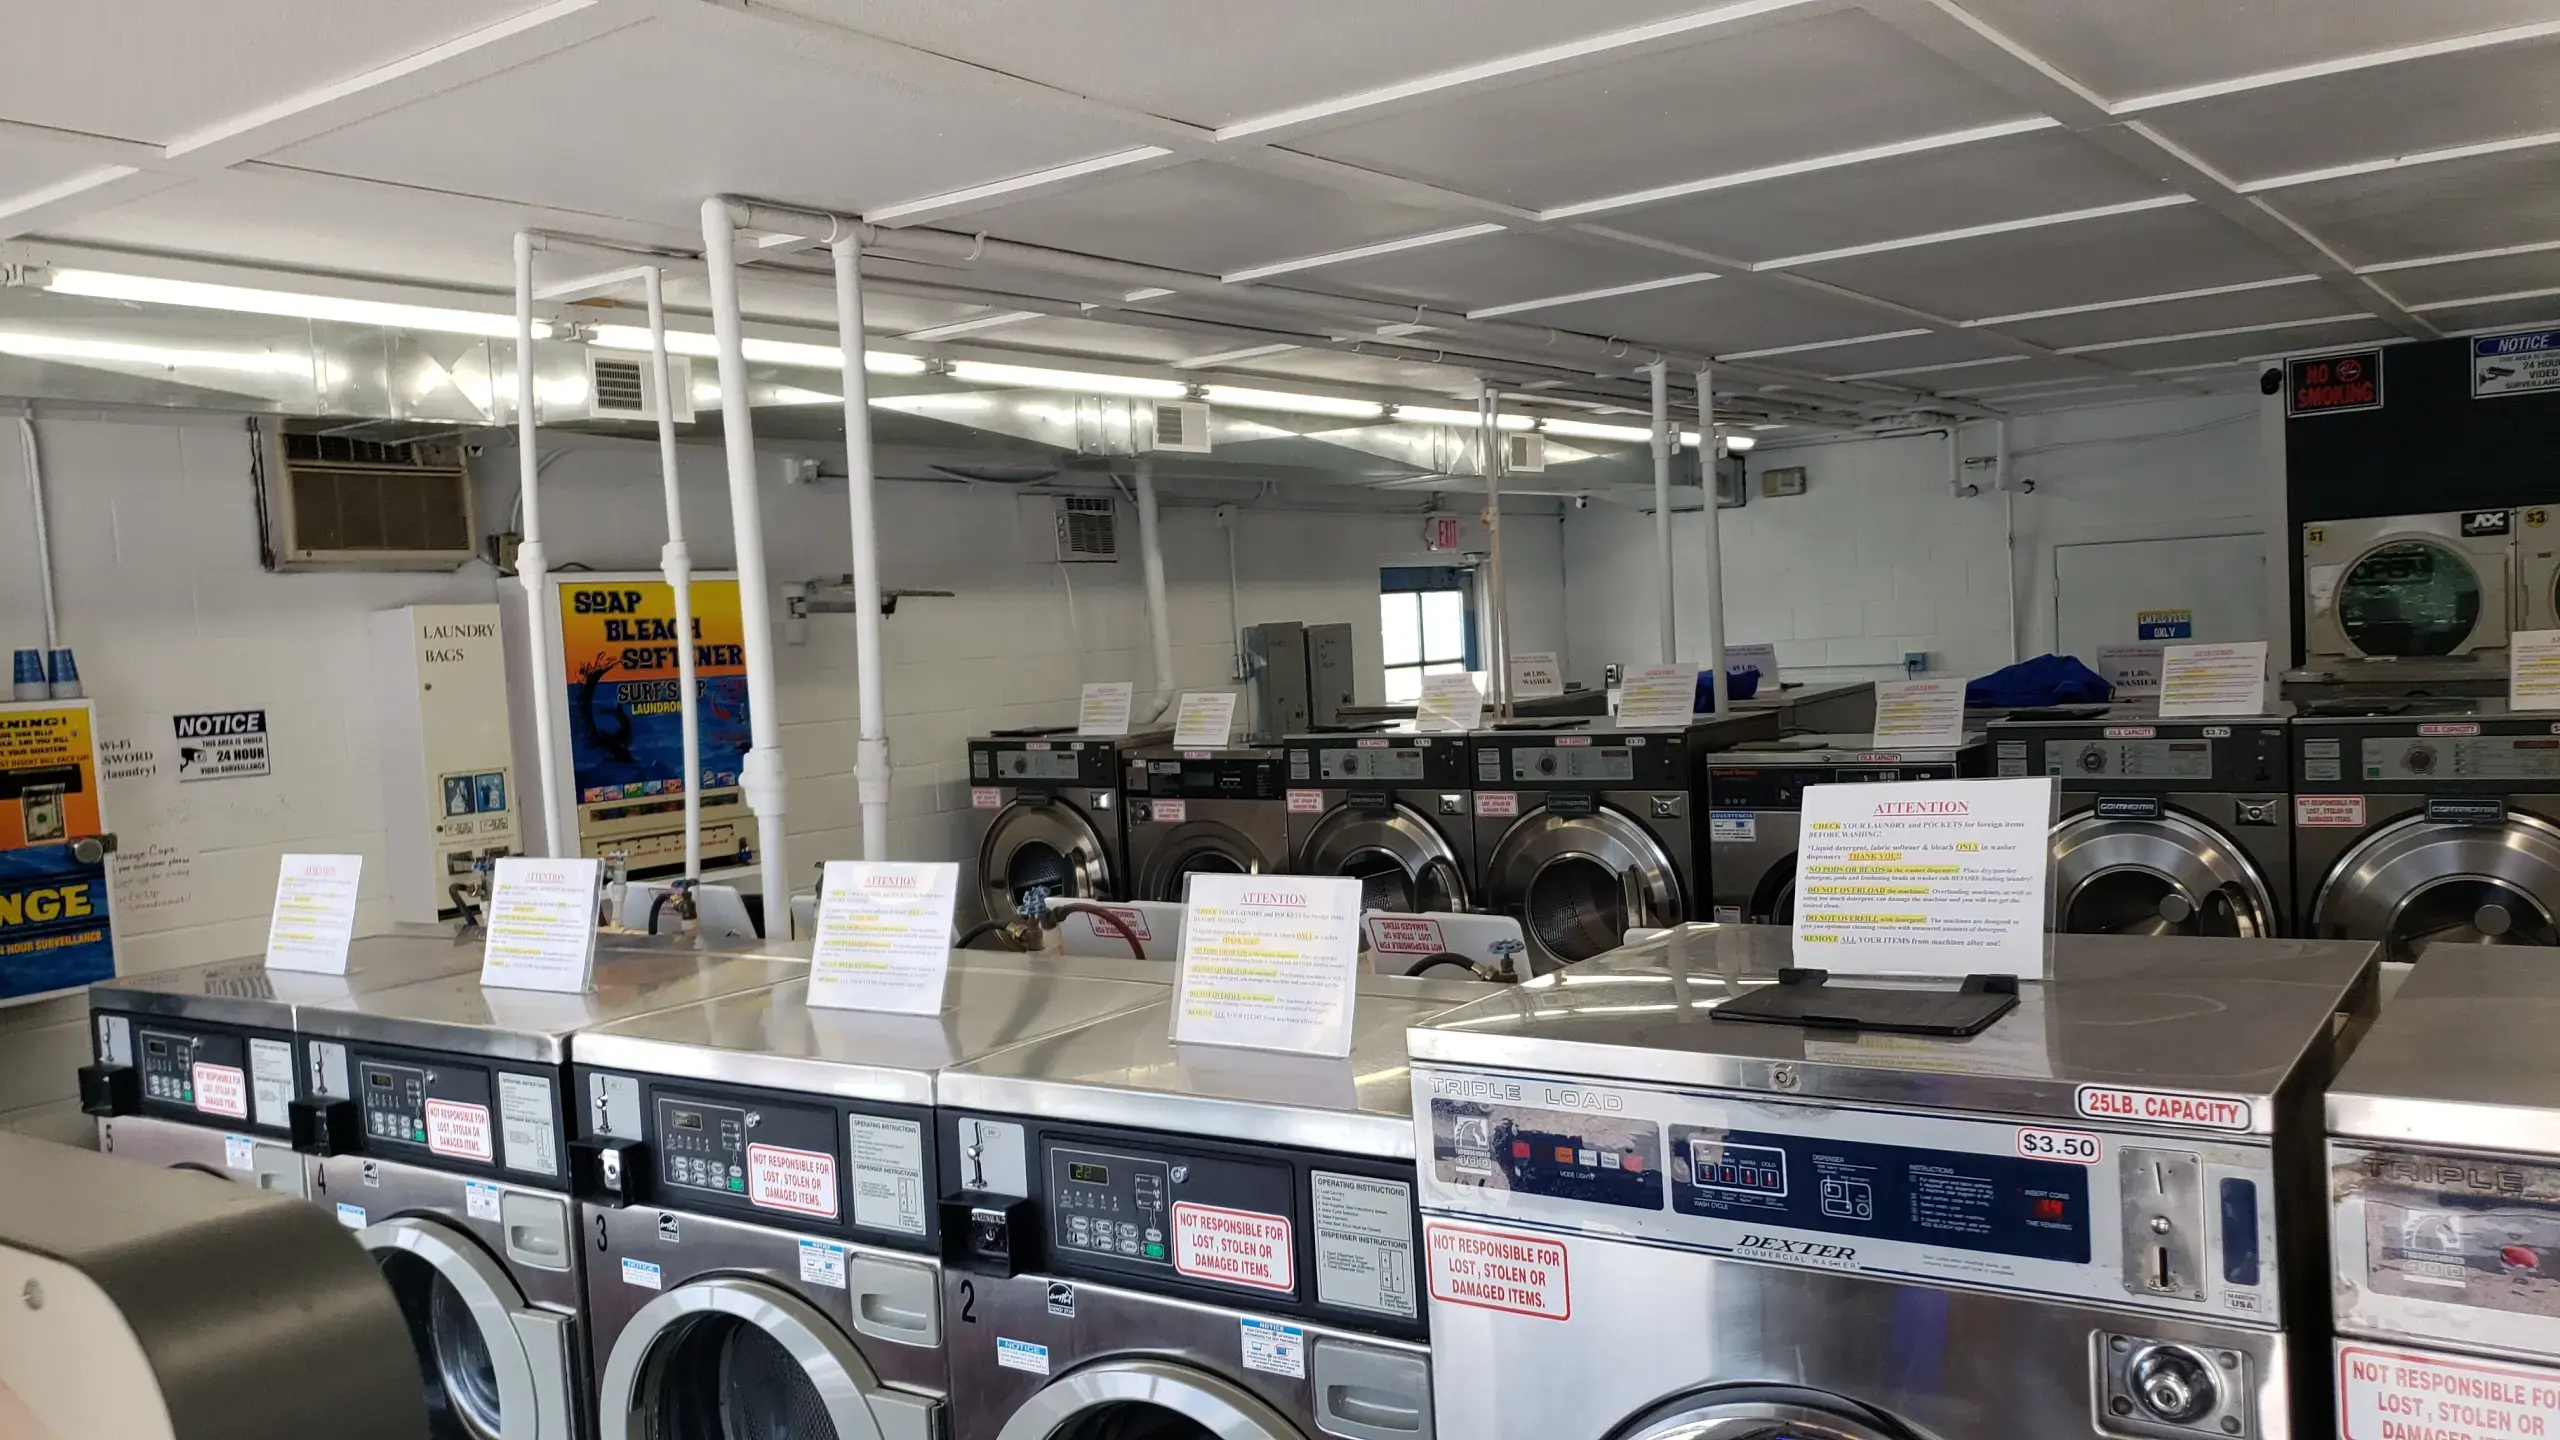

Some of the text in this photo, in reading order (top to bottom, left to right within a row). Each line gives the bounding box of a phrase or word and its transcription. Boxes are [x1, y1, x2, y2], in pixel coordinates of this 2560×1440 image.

[2498, 334, 2549, 352] NOTICE
[2307, 363, 2329, 384] NO
[2529, 369, 2558, 378] VIDEO
[2298, 381, 2373, 408] SMOKING
[2473, 512, 2504, 528] ADC
[574, 591, 642, 614] SOAP
[2140, 614, 2189, 624] EMPLOYEES
[423, 624, 496, 639] LAUNDRY
[2154, 627, 2175, 637] ONLY
[425, 649, 464, 663] BAGS
[623, 644, 745, 670] SOFTNER
[617, 681, 678, 703] SURF'S
[179, 713, 260, 737] NOTICE
[218, 739, 233, 747] AREA
[243, 736, 263, 744] UNDER
[217, 747, 264, 762] 24 HOUR
[201, 763, 265, 775] VIDEO SURVEILLANCE
[1874, 801, 1969, 814] ATTENTION
[1977, 821, 2003, 829] foreign
[1842, 830, 1882, 838] WASHING!
[1955, 843, 1979, 851] ONLY
[1806, 853, 1841, 861] dispensers
[865, 876, 916, 886] ATTENTION
[1840, 886, 1886, 894] OVERLOAD
[1241, 893, 1307, 904] ATTENTION
[7, 942, 33, 955] HOUR
[36, 931, 101, 950] SURVEILLANCE
[1931, 938, 1965, 946] machines
[1429, 1077, 1623, 1111] TRIPLE LOAD
[430, 1107, 485, 1124] NOT RESPONSIBLE FOR
[2089, 1092, 2240, 1124] 25LB. CAPACITY
[453, 1124, 471, 1137] STOLEN
[473, 1126, 480, 1137] OR
[854, 1119, 917, 1135] OPERATING INSTRUCTIONS
[105, 1124, 113, 1152] 5
[440, 1136, 481, 1152] DAMAGED ITEMS.
[2023, 1133, 2095, 1157] $3.50
[753, 1153, 829, 1175] NOT RESPONSIBLE FOR
[1455, 1156, 1492, 1169] 400
[1812, 1154, 1844, 1163] DISPENSER
[857, 1163, 919, 1178] DISPENSER INSTRUCTIONS
[1560, 1171, 1595, 1180] MODE LIGHTS
[1909, 1165, 1954, 1175] INSTRUCTIONS
[2362, 1157, 2524, 1194] TRIPLE
[318, 1162, 326, 1195] 4
[785, 1173, 810, 1189] STOLEN
[812, 1178, 821, 1190] OR
[1318, 1178, 1405, 1197] OPERATING INSTRUCTIONS
[765, 1187, 822, 1207] DAMAGED ITEMS.
[2049, 1192, 2069, 1200] COINS
[1694, 1200, 1729, 1210] WASH CYCLE
[596, 1214, 607, 1252] 3
[1180, 1213, 1283, 1241] NOT RESPONSIBLE FOR
[2039, 1221, 2073, 1231] REMAINING
[1222, 1238, 1256, 1256] STOLEN
[1259, 1244, 1272, 1259] OR
[1321, 1231, 1407, 1250] DISPENSER INSTRUCTIONS
[1737, 1235, 1856, 1260] DEXTER
[1433, 1233, 1560, 1267] NOT RESPONSIBLE FOR
[1195, 1254, 1272, 1278] DAMAGED ITEMS.
[1737, 1248, 1856, 1269] COMMERCIAL WASHER
[1484, 1262, 1526, 1284] STOLEN
[1530, 1270, 1546, 1286] OR
[2403, 1260, 2466, 1278] 400
[960, 1278, 977, 1324] 2
[1452, 1279, 1545, 1308] DAMAGED ITEMS.
[1064, 1307, 1073, 1315] STAR
[2232, 1300, 2253, 1309] USA
[1260, 1322, 1284, 1331] NOTICE
[1005, 1341, 1040, 1353] NOTICE
[2353, 1360, 2390, 1384] NOT
[2396, 1367, 2526, 1405] RESPONSIBLE
[2438, 1401, 2512, 1432] STOLEN
[2518, 1414, 2545, 1436] OR
